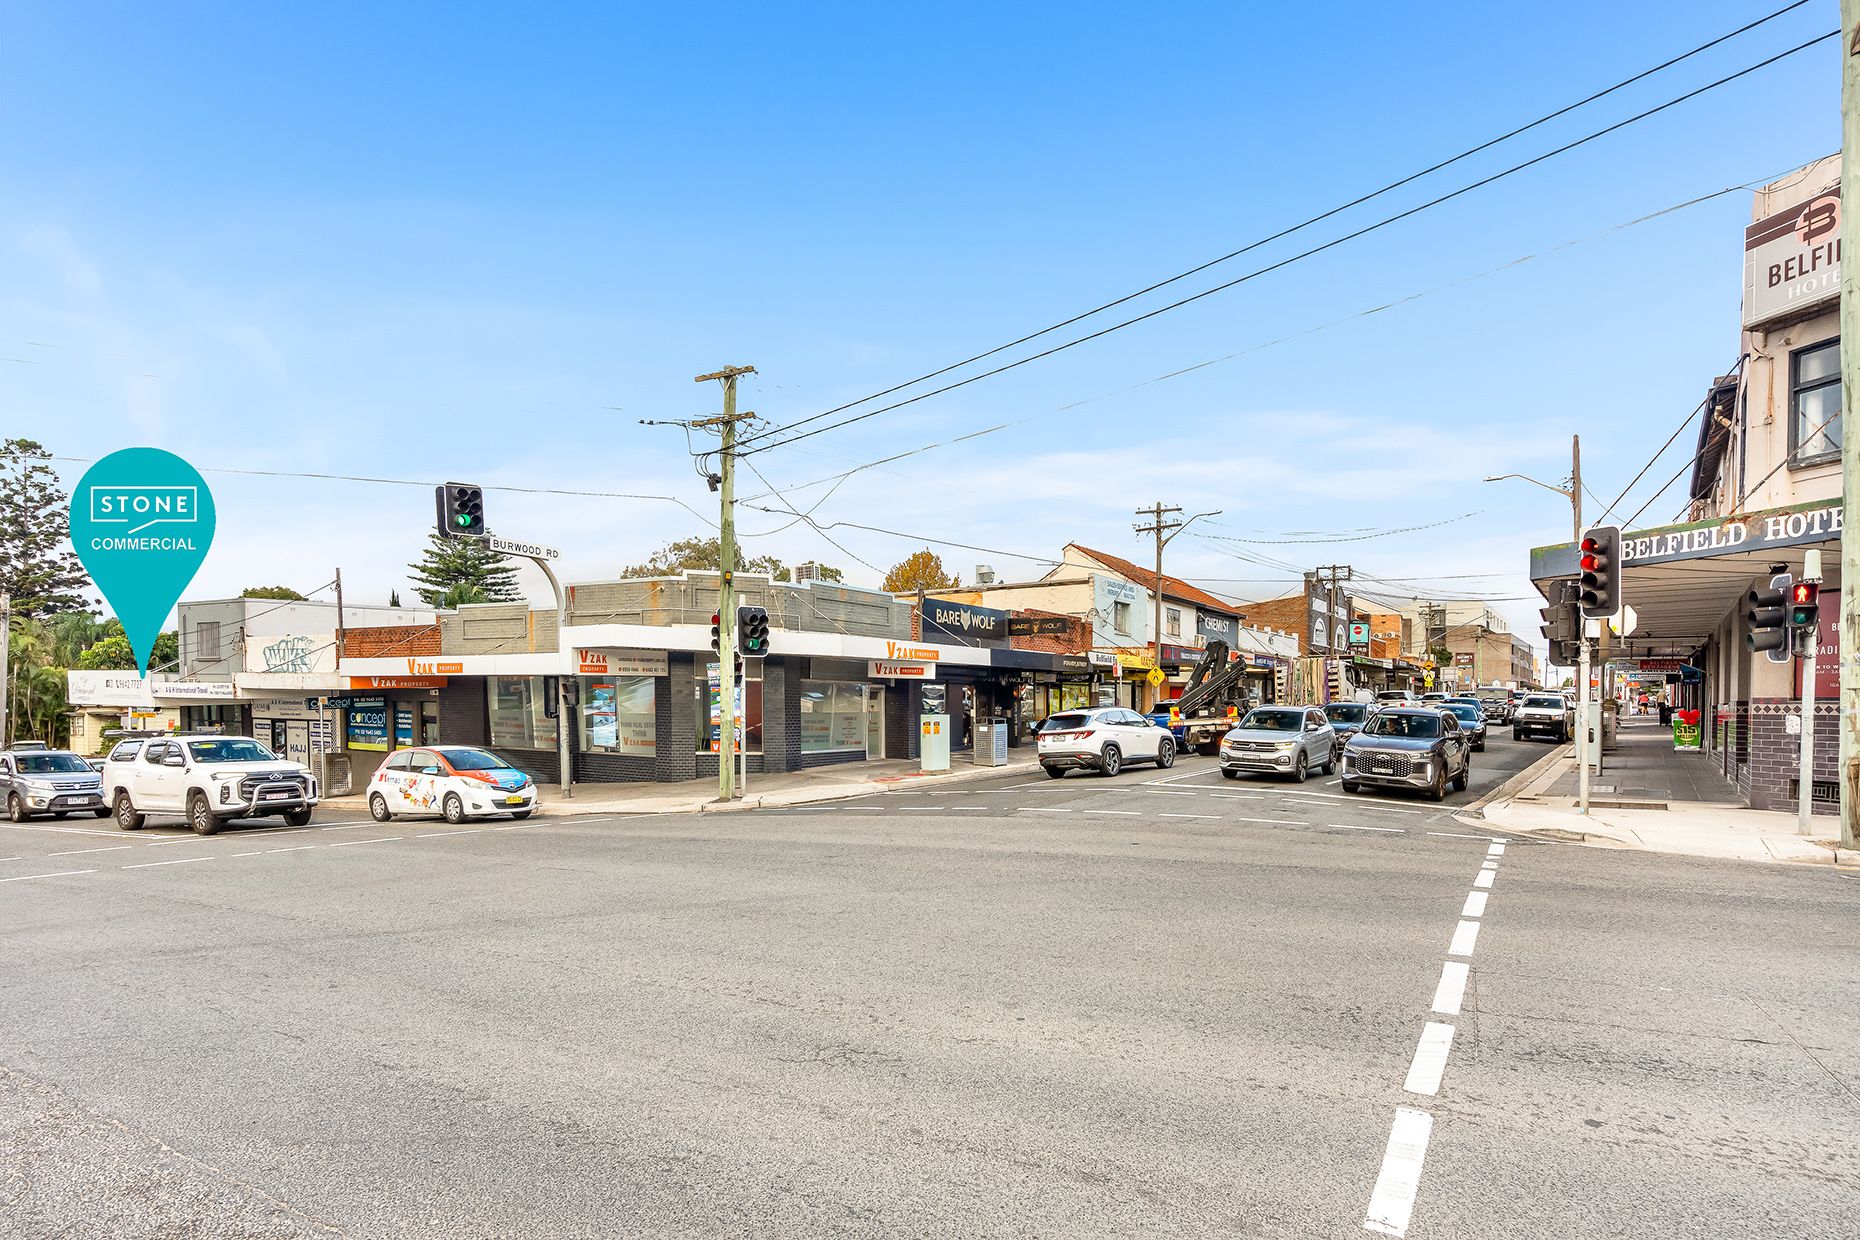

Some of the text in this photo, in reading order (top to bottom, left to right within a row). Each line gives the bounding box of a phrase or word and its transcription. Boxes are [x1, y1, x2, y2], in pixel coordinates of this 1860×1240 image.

[1768, 239, 1841, 288] BELFI
[1788, 270, 1841, 299] HOTE
[1621, 506, 1842, 561] BELFIELD HOTE
[493, 539, 559, 558] BURWOOD RD
[936, 609, 995, 630] BARE WOLF
[1205, 617, 1229, 633] CHEMIST
[310, 698, 351, 707] ccept
[290, 744, 307, 753] HAJJ
